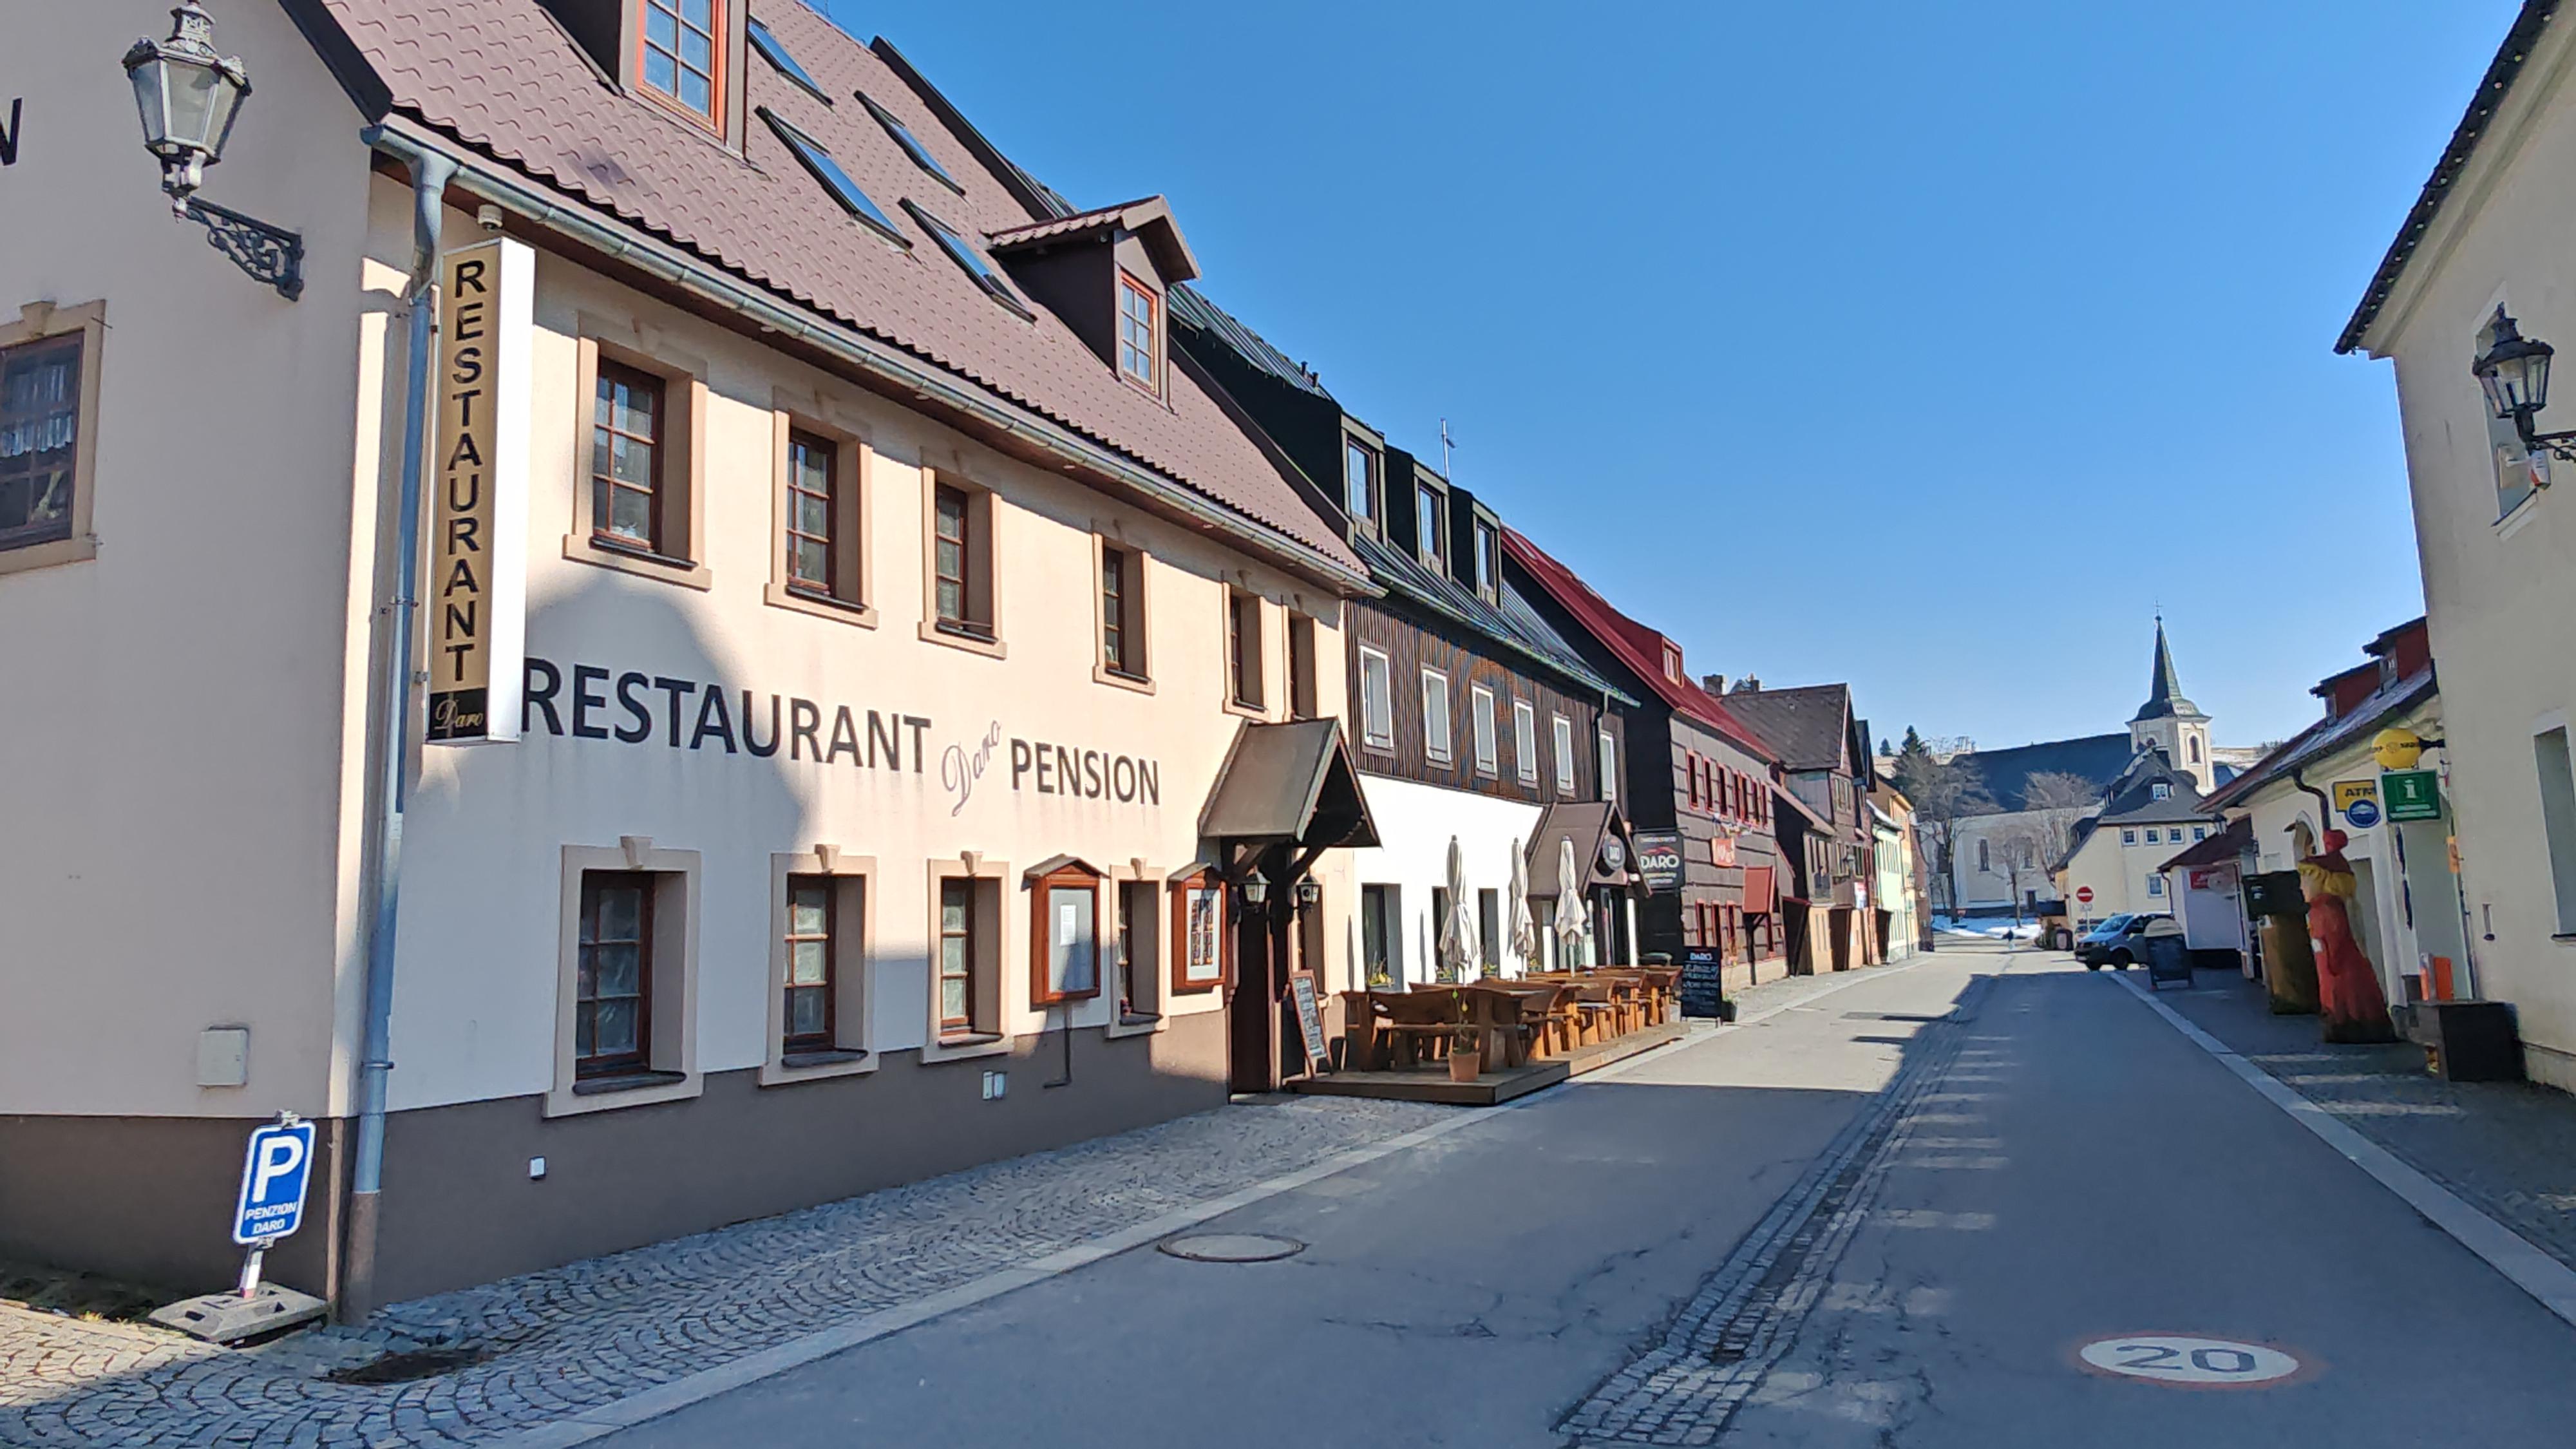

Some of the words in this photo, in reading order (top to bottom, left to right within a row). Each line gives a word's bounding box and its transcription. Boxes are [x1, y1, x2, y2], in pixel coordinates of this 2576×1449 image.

[442, 260, 487, 681] RESTAURANT
[434, 699, 484, 730] Daro
[522, 656, 932, 773] RESTAURANT
[942, 719, 1001, 817] Daro
[1010, 737, 1159, 806] PENSION
[1640, 855, 1680, 869] DARO
[1689, 952, 1713, 961] DARO
[252, 1136, 303, 1202] P
[245, 1202, 297, 1220] PENZION
[253, 1219, 285, 1234] DARO
[2116, 1345, 2258, 1373] 20
